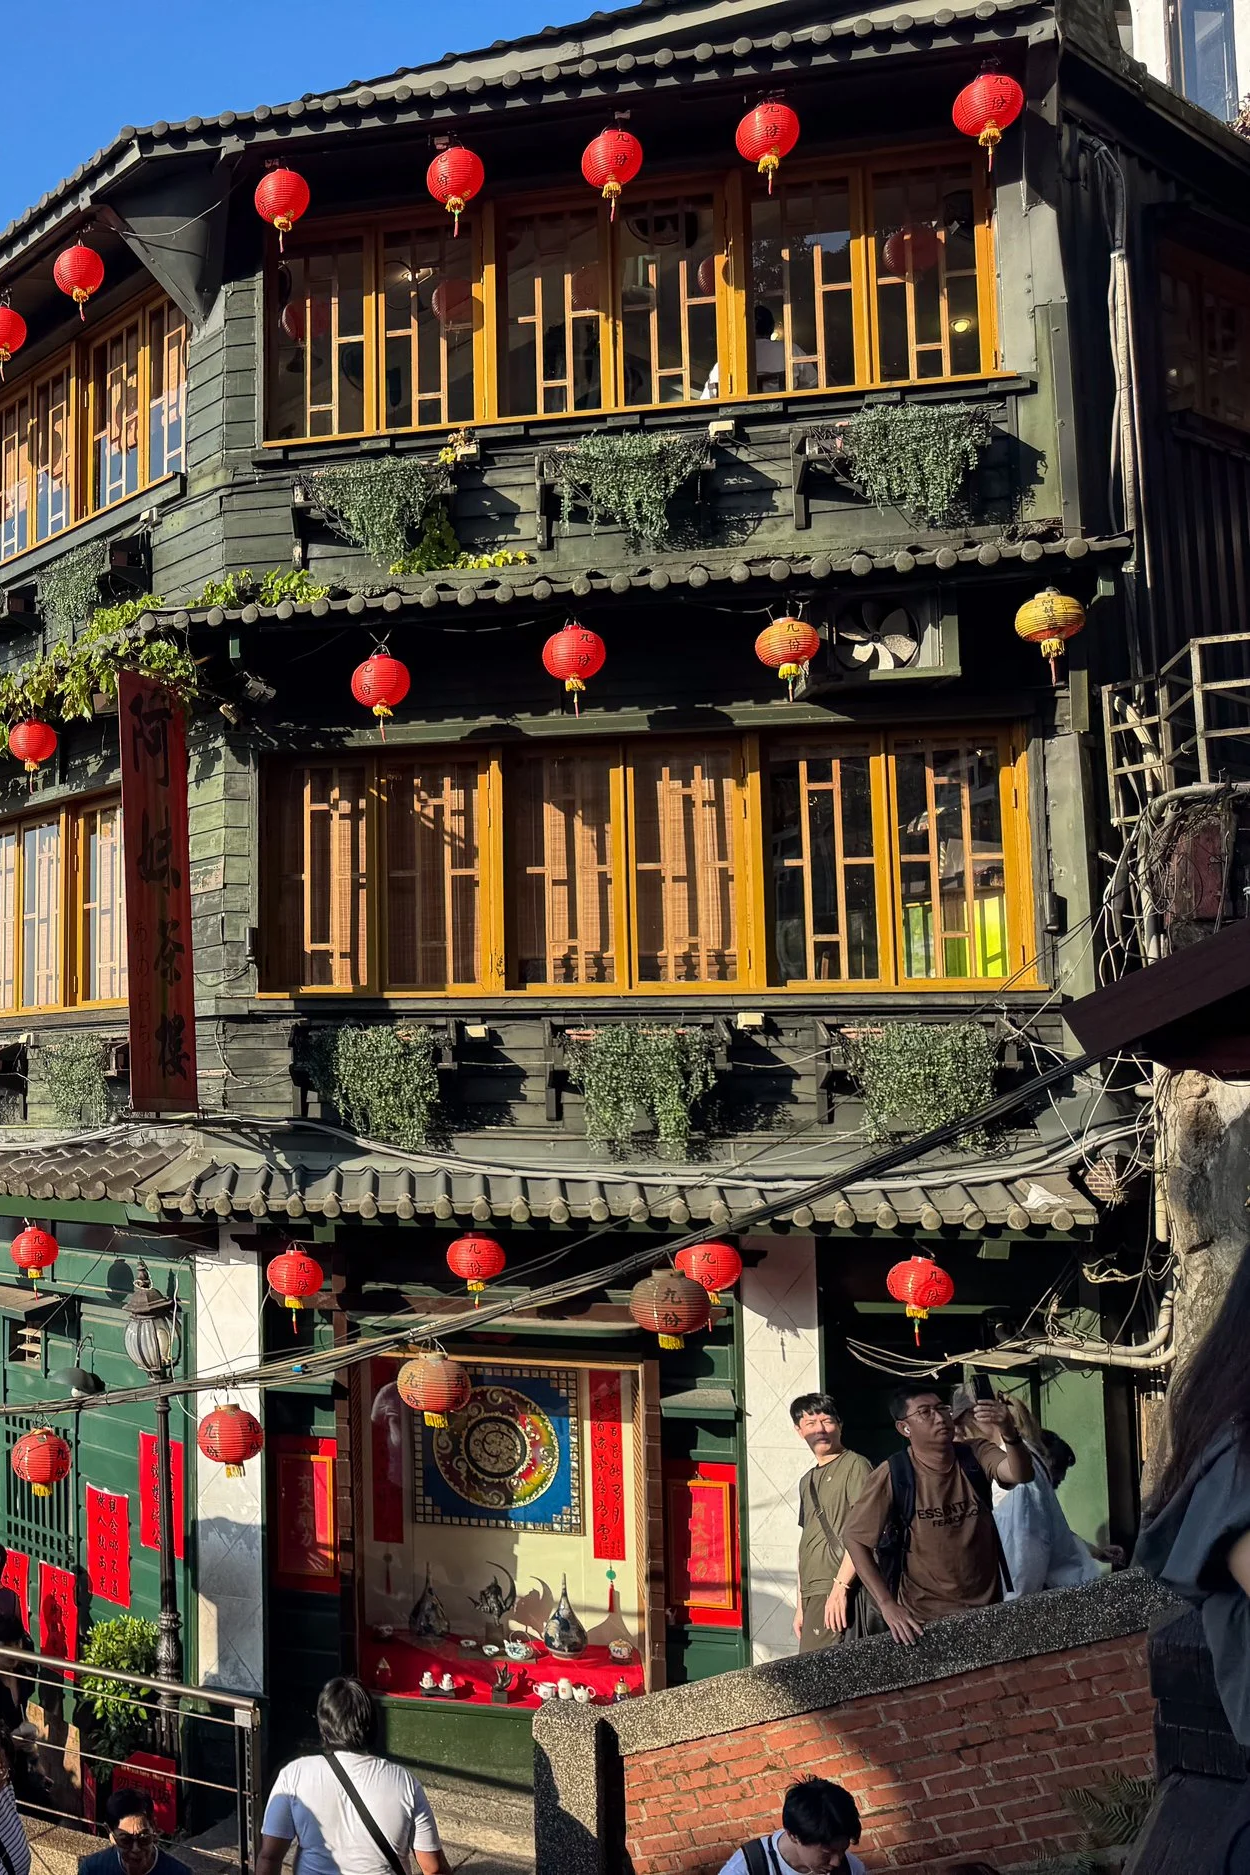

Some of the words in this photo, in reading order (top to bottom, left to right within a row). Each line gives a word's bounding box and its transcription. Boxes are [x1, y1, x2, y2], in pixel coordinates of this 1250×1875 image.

[577, 633, 595, 667] 九份
[786, 624, 800, 652] 九份
[128, 687, 191, 1081] 阿妹茶樓
[33, 1235, 44, 1262] 九份
[469, 1243, 482, 1275] 九份
[298, 1262, 310, 1290] 九份
[700, 1252, 717, 1286] 九份
[927, 1271, 943, 1302] 九份
[661, 1287, 682, 1328] 九份
[203, 1422, 219, 1458] 九份
